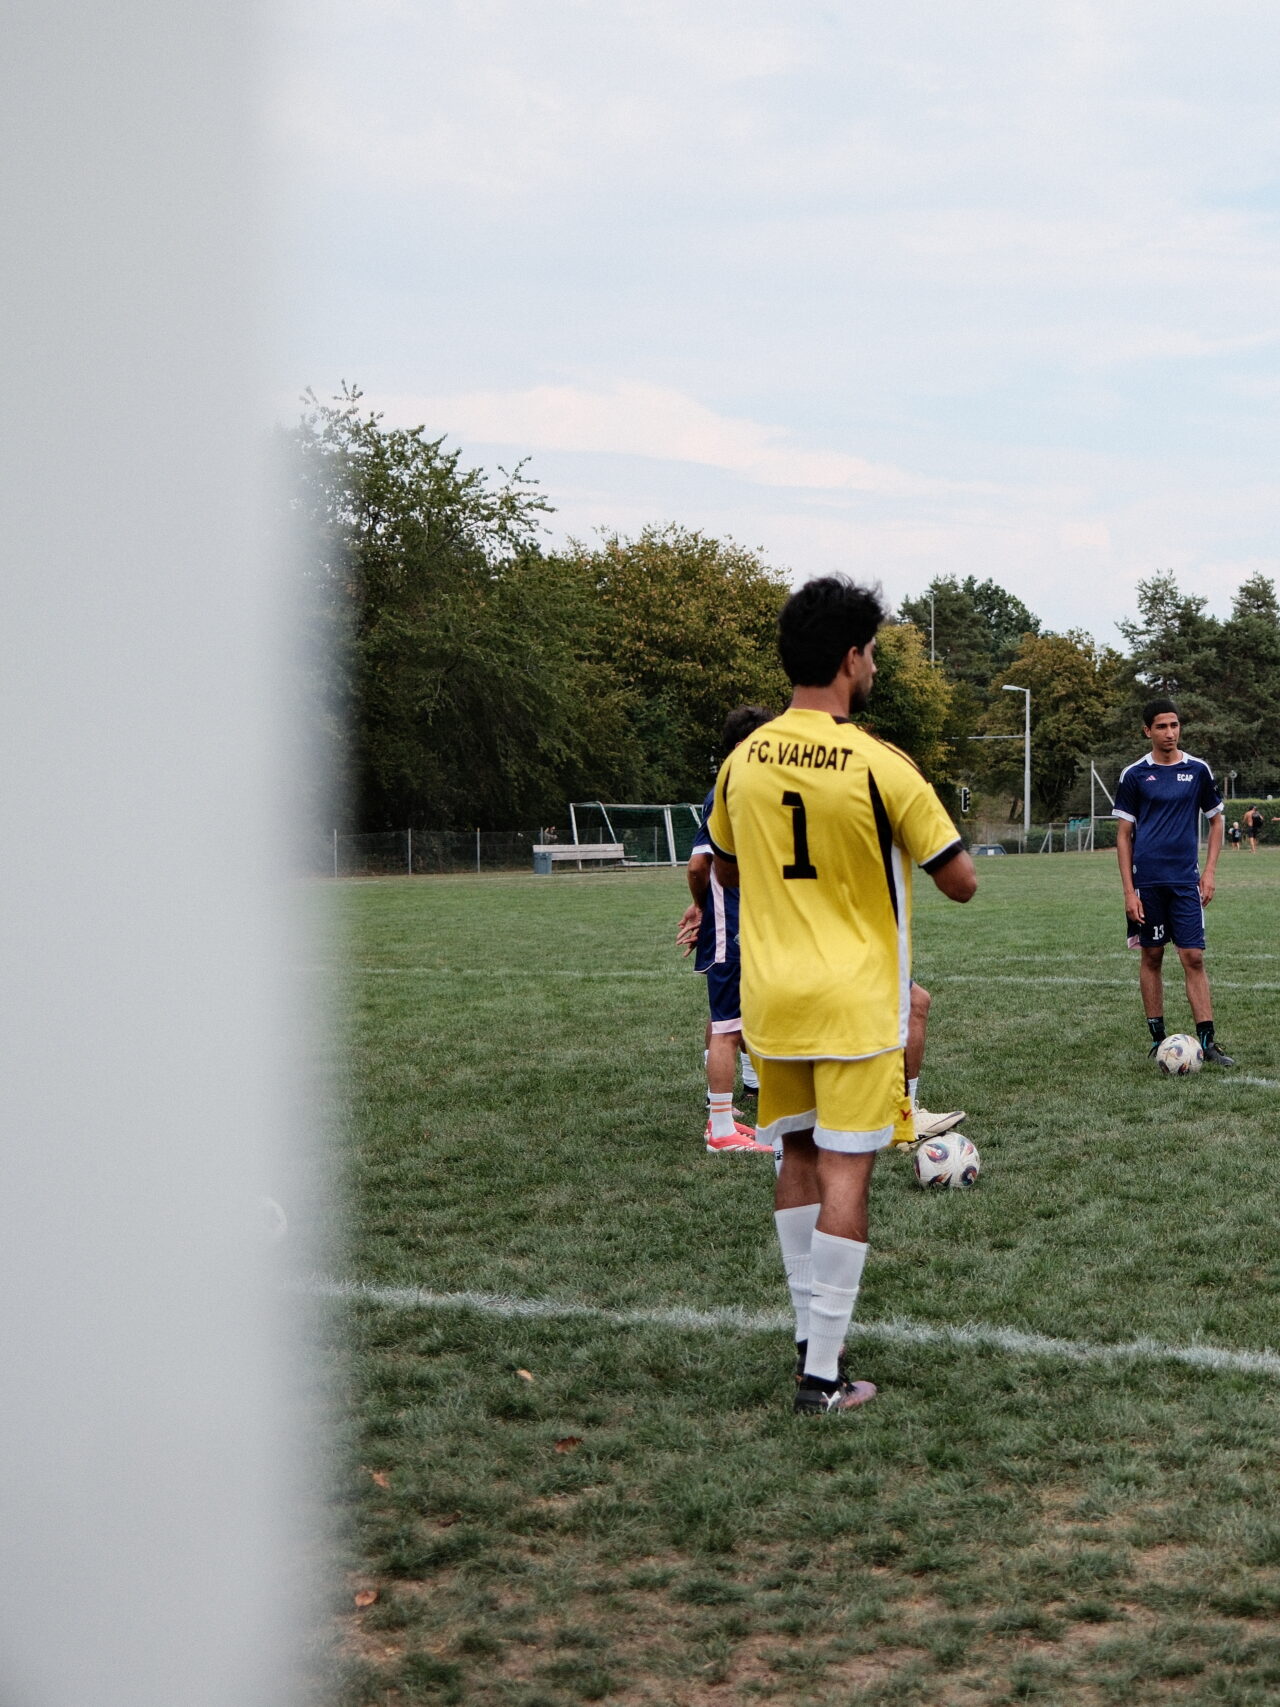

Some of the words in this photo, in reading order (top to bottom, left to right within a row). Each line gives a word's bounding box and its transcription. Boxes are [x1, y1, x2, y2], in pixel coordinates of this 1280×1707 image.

[747, 740, 853, 771] FC.VAHDAT
[1176, 773, 1194, 782] ECAP
[781, 790, 818, 880] 1
[1152, 924, 1165, 940] 13
